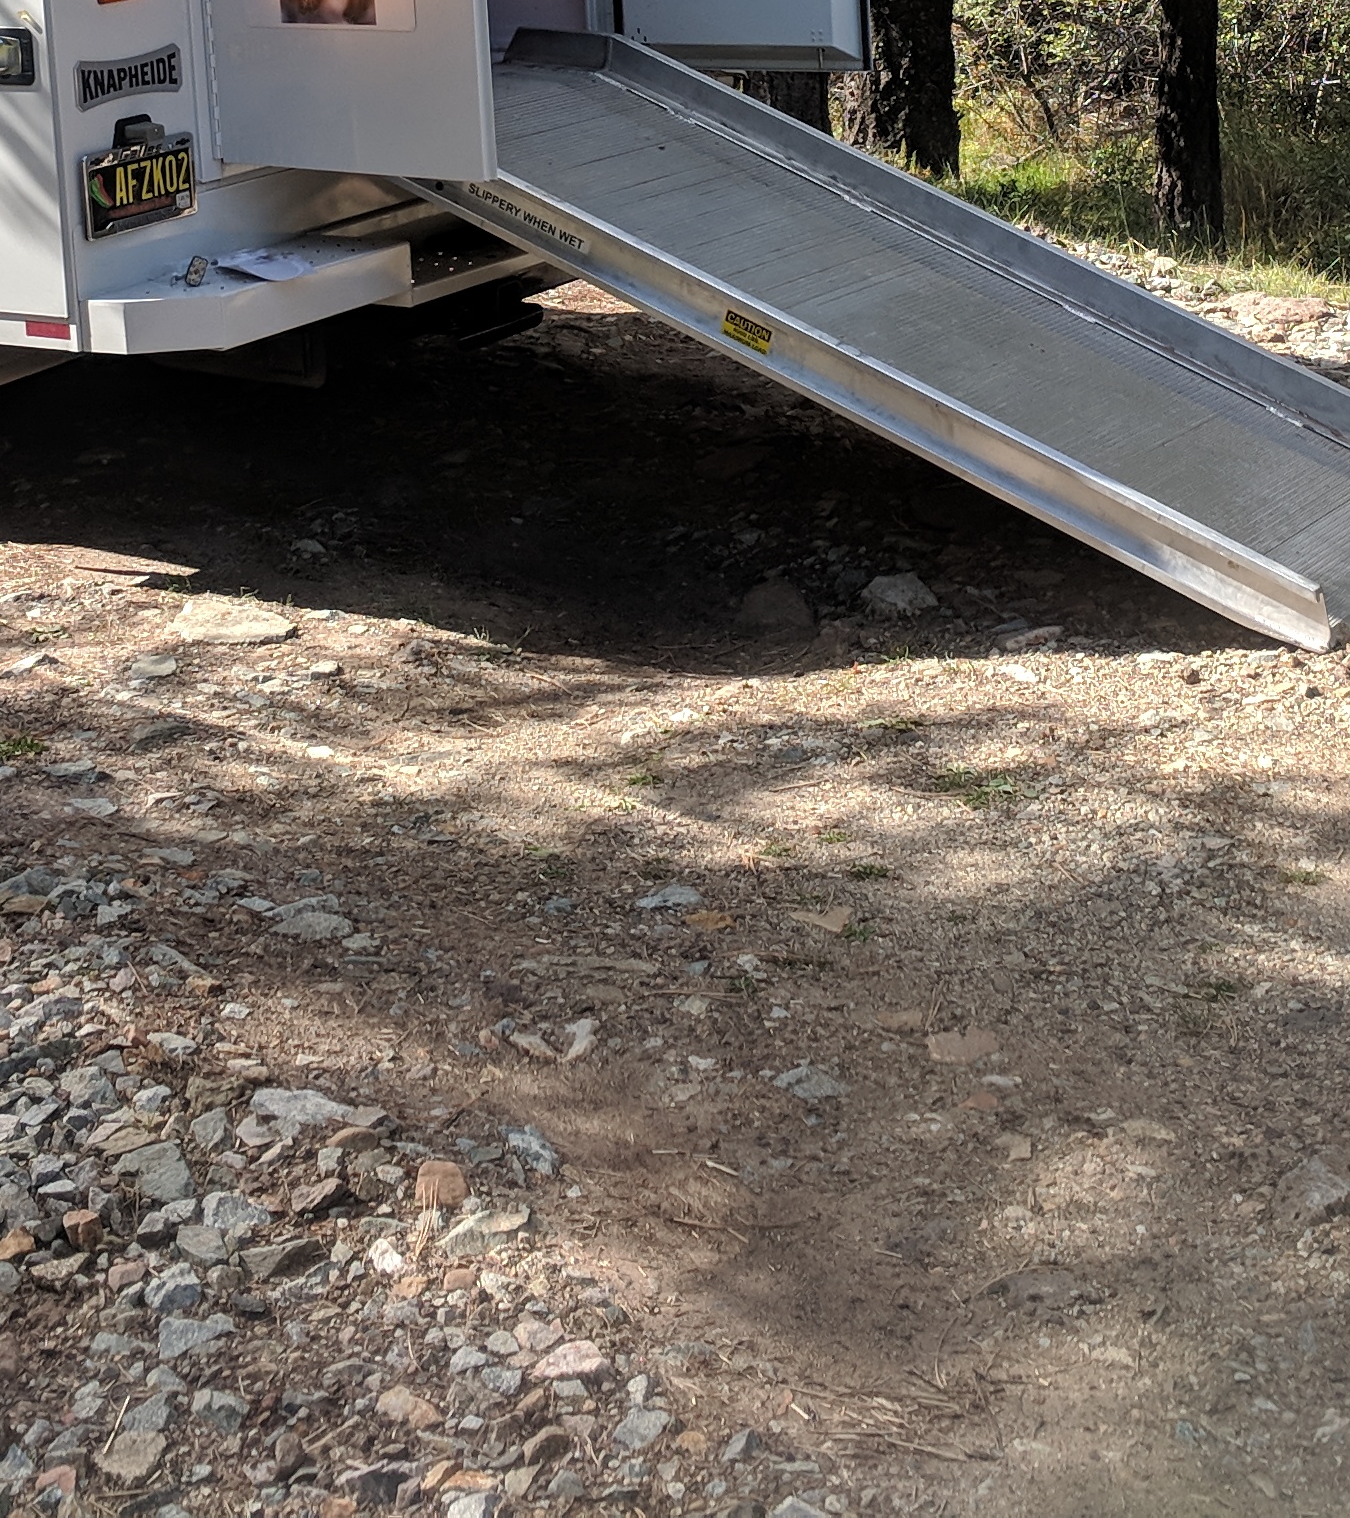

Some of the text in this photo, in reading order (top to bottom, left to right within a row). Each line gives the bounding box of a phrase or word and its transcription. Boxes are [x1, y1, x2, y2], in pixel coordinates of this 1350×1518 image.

[80, 51, 179, 104] KNAPHEIDE
[468, 182, 585, 250] SLIPPERY WHEN WET
[727, 313, 770, 341] CAUTION
